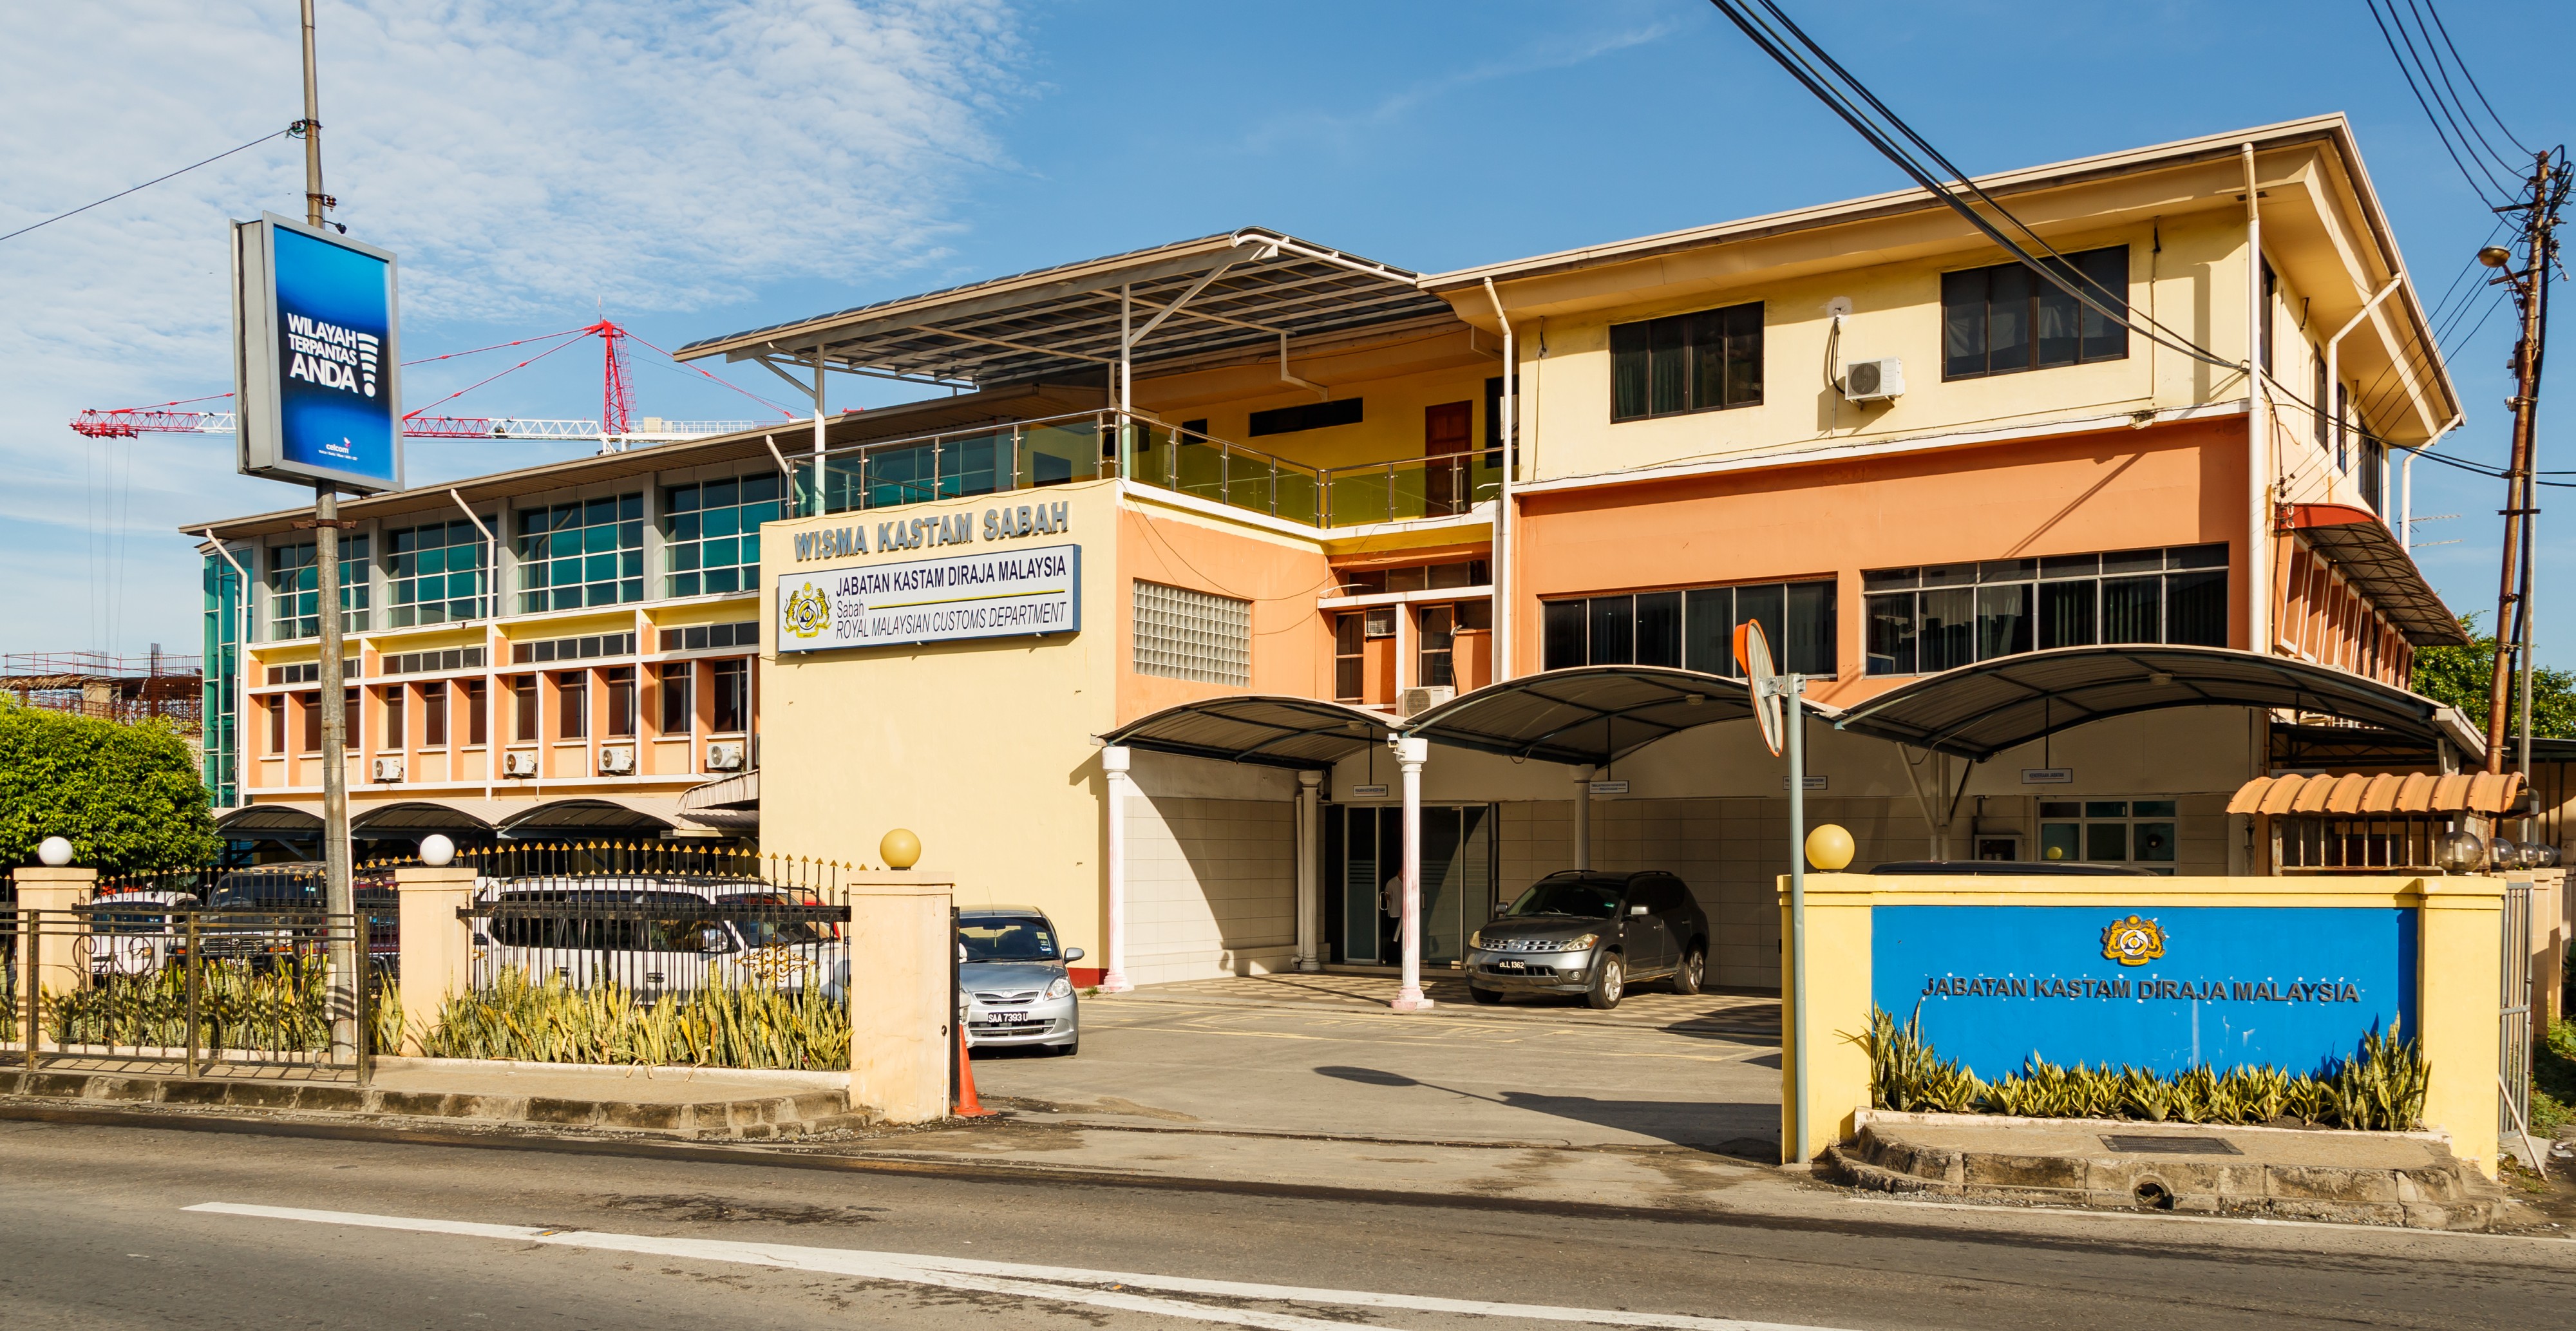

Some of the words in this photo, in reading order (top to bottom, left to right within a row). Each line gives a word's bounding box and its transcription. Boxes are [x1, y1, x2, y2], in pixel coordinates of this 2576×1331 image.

[287, 312, 357, 349] WILAYAH
[288, 333, 357, 366] TERPANTAS
[326, 444, 349, 454] celcom
[793, 525, 869, 562] WISMA
[877, 512, 974, 553] KASTAM
[983, 500, 1069, 541] SABAH
[837, 572, 890, 598] JABATAN
[894, 567, 945, 592] KASTAM
[949, 562, 996, 587] DIRAJA
[998, 555, 1066, 581] MALAYSIA
[836, 617, 869, 640] ROYAL
[871, 612, 931, 638] MALAYSIAN
[933, 607, 987, 632] CUSTOMS
[989, 601, 1067, 627] DEPARTMENT
[837, 598, 864, 619] Sabah
[1921, 976, 2027, 997] JABATAN
[2034, 977, 2131, 999] KASTAM
[2138, 979, 2227, 1001] DIRAJA
[2233, 981, 2360, 1003] MALAYSIA
[989, 1014, 1002, 1023] SAA
[1003, 1014, 1022, 1022] 7393
[1023, 1013, 1028, 1021] U
